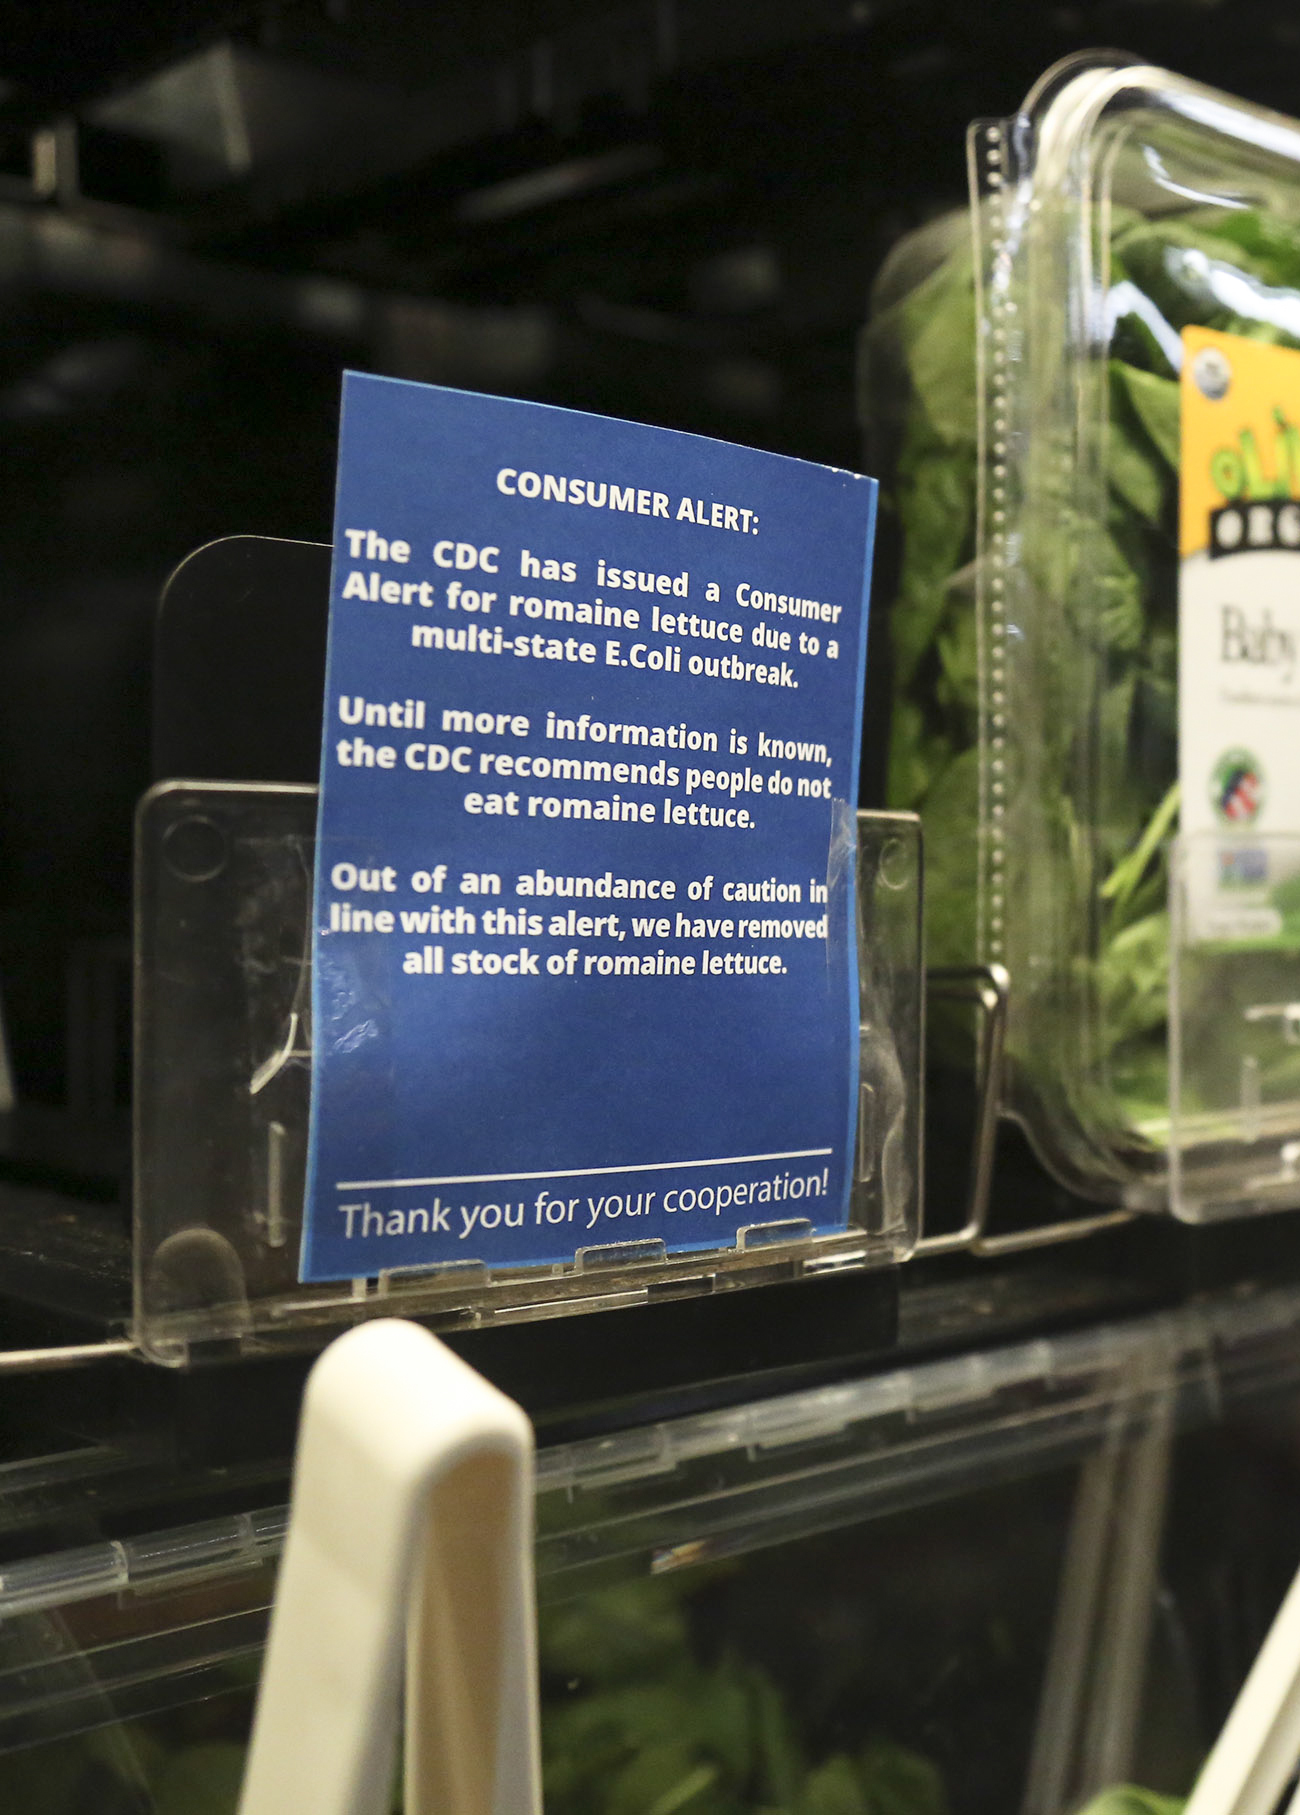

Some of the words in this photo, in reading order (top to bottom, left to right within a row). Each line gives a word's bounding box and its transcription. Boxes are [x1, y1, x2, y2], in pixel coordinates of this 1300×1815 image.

[496, 467, 671, 519] CONSUMER
[675, 497, 759, 536] ALERT:
[344, 528, 412, 564] The
[432, 540, 501, 574] CDC
[520, 549, 577, 583] has
[596, 559, 689, 598] issued
[705, 582, 720, 603] a
[735, 582, 843, 624] Consumer
[341, 570, 435, 608] Alert
[445, 580, 498, 614] for
[509, 594, 640, 630] romaine
[651, 605, 743, 644] lettuce
[751, 621, 792, 651] due
[798, 631, 821, 656] to
[826, 639, 840, 660] a
[1219, 604, 1298, 685] Baby
[411, 623, 597, 664] multi-state
[605, 639, 682, 673] E.Coli
[688, 654, 799, 689] outbreak.
[338, 695, 426, 730] Until
[441, 709, 530, 737] more
[545, 710, 718, 752] information
[729, 727, 748, 755] is
[757, 731, 833, 768] known,
[335, 736, 398, 769] the
[404, 742, 473, 774] CDC
[479, 753, 680, 787] recommends
[685, 767, 764, 799] people
[767, 769, 794, 796] do
[797, 777, 833, 800] not
[463, 791, 520, 816] eat
[527, 794, 656, 823] romaine
[663, 798, 756, 829] lettuce.
[330, 862, 398, 893] Out
[410, 864, 448, 894] of
[459, 872, 502, 895] an
[515, 868, 676, 900] abundance
[687, 875, 715, 901] of
[722, 876, 802, 903] caution
[809, 878, 829, 904] in
[328, 902, 395, 935] line
[399, 904, 477, 935] with
[480, 907, 544, 936] this
[547, 909, 627, 942] alert,
[631, 917, 671, 938] we
[675, 912, 735, 939] have
[738, 913, 830, 940] removed
[402, 944, 445, 975] all
[450, 947, 540, 976] stock
[546, 948, 580, 976] of
[583, 949, 696, 976] romaine
[701, 949, 788, 975] lettuce.
[339, 1197, 451, 1238] Thank
[458, 1202, 525, 1240] you
[534, 1191, 580, 1225] for
[586, 1191, 656, 1229] your
[663, 1167, 829, 1216] cooperation!
